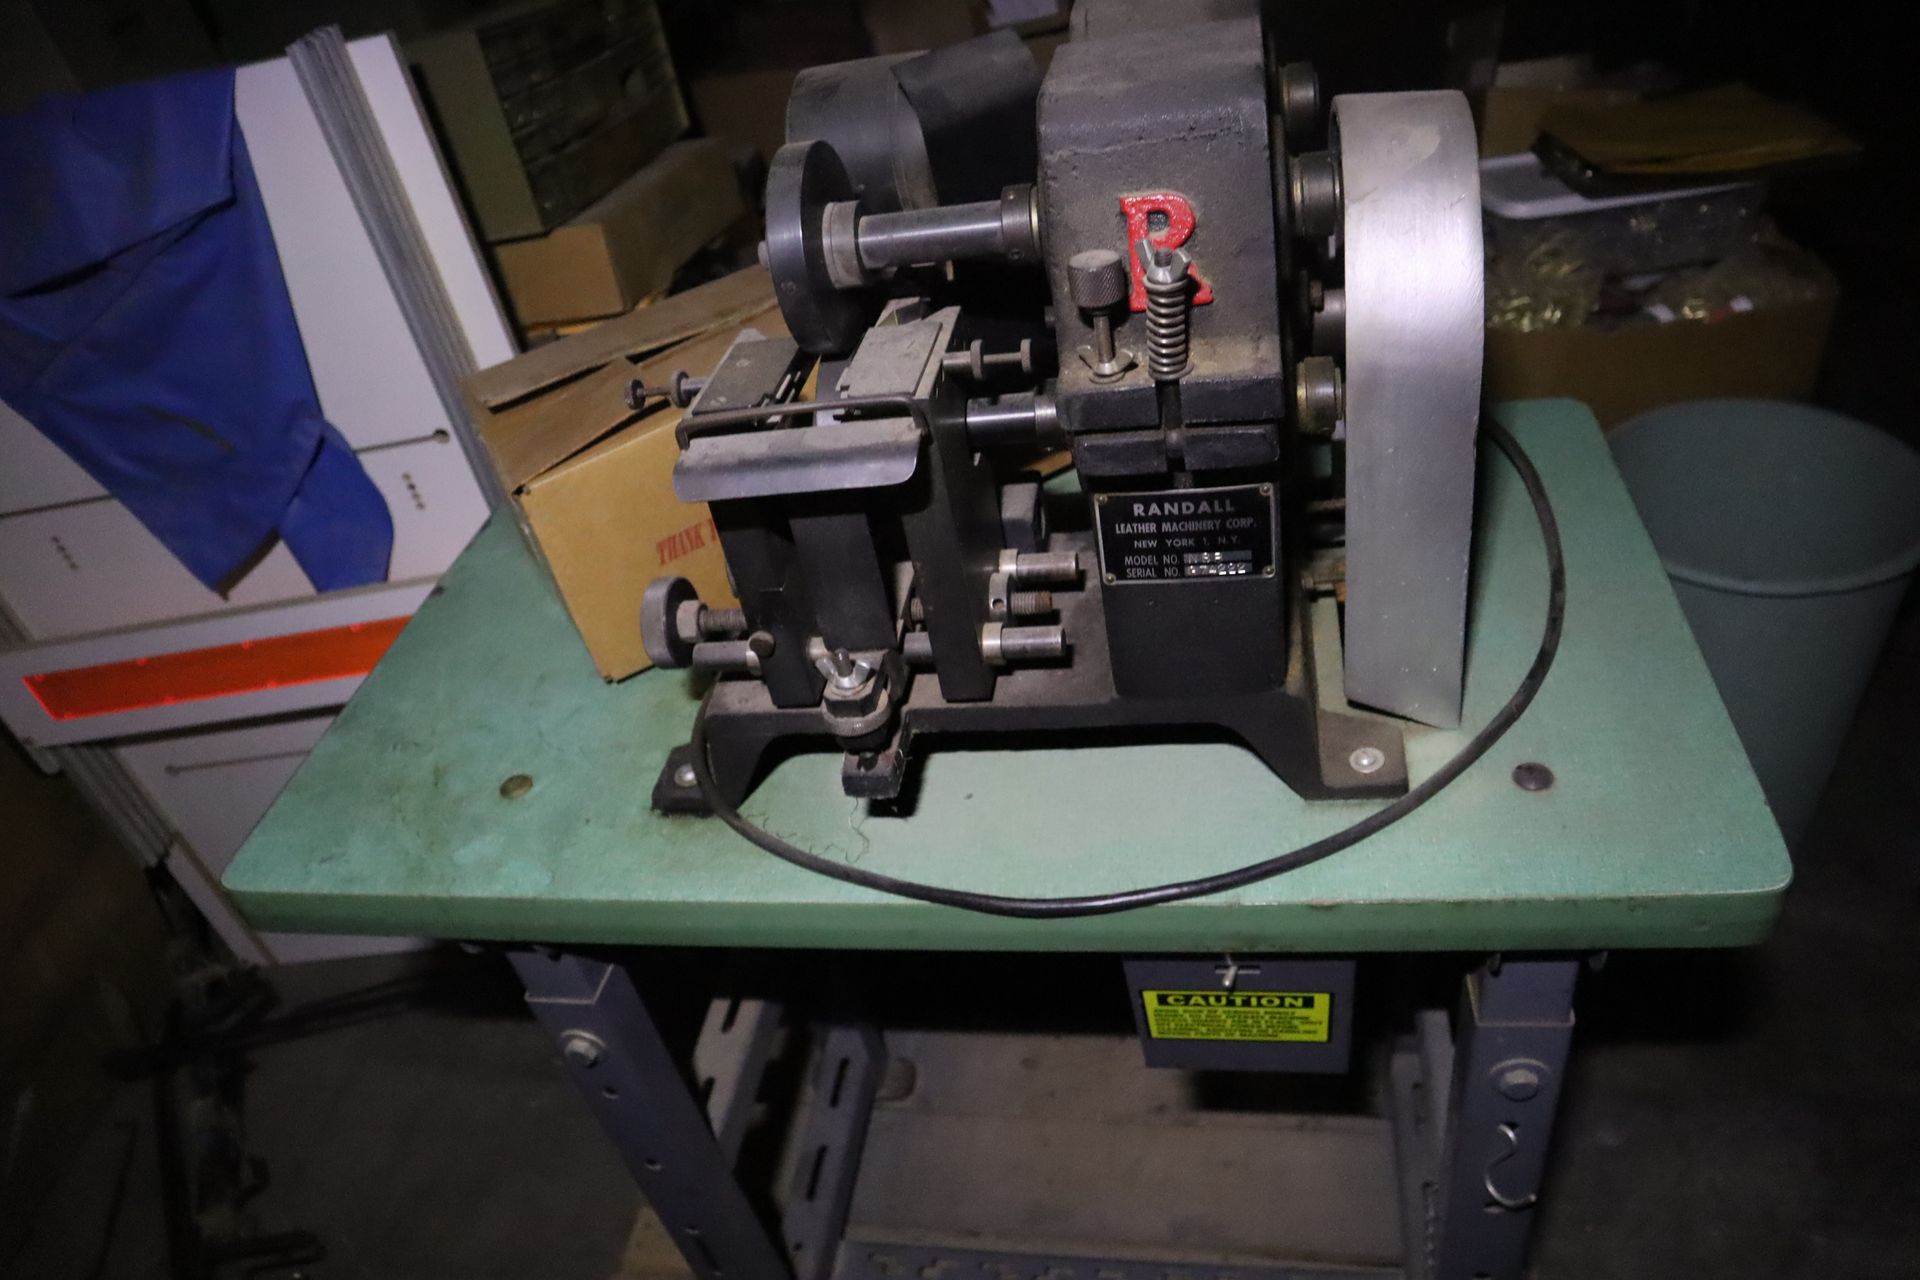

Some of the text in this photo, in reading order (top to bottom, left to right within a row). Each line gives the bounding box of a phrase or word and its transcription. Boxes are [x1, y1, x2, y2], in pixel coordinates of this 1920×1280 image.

[1120, 192, 1215, 312] R
[1132, 499, 1235, 517] RANDALL
[1115, 517, 1257, 535] LEATHER MACHINERY CORP.
[656, 521, 706, 567] THANK
[1134, 540, 1158, 549] NEW
[1165, 537, 1195, 548] YORK
[1124, 554, 1159, 566] MODEL
[1163, 553, 1181, 565] NO.
[1126, 566, 1157, 578] SERIAL
[1164, 566, 1181, 577] NO.
[1167, 995, 1304, 1008] CAUTION
